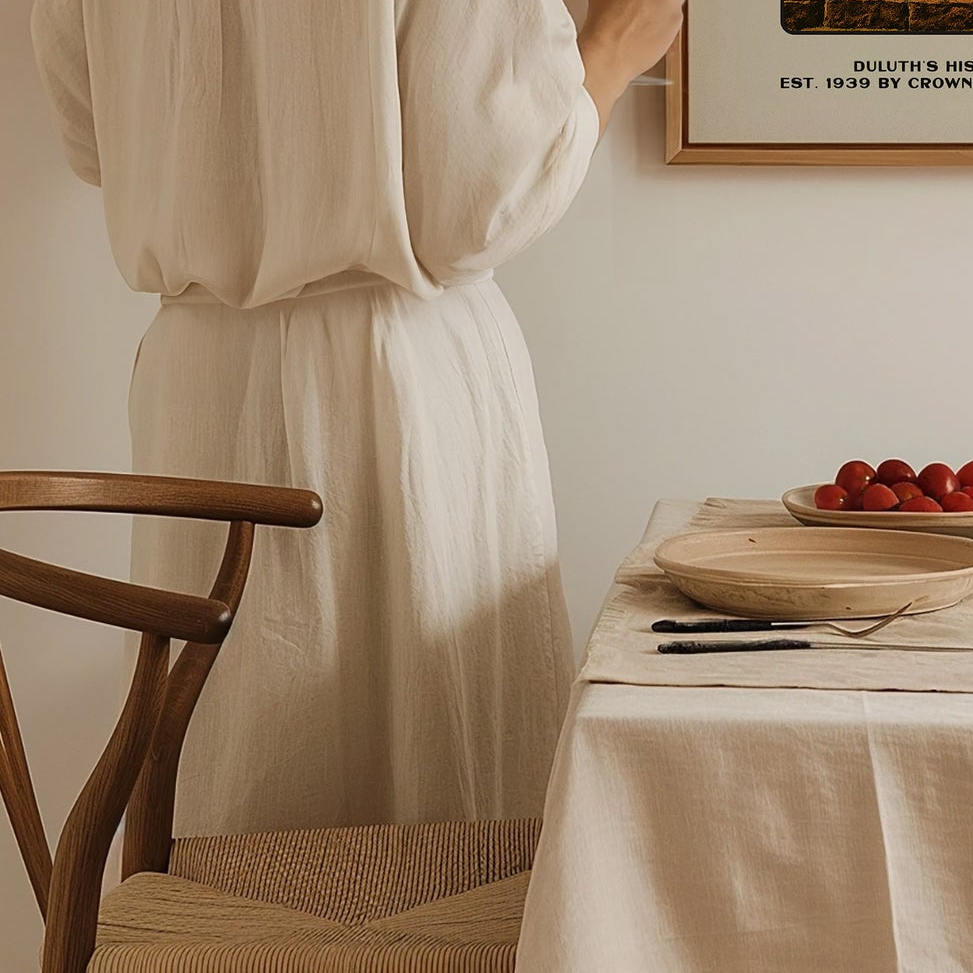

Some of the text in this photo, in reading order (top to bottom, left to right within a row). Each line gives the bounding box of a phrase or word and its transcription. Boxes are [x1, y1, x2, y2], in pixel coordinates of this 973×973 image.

[853, 60, 939, 73] DULUTH'S
[780, 77, 818, 90] EST.
[826, 77, 871, 90] 1939
[878, 77, 902, 89] BY
[907, 77, 973, 90] CROWN
